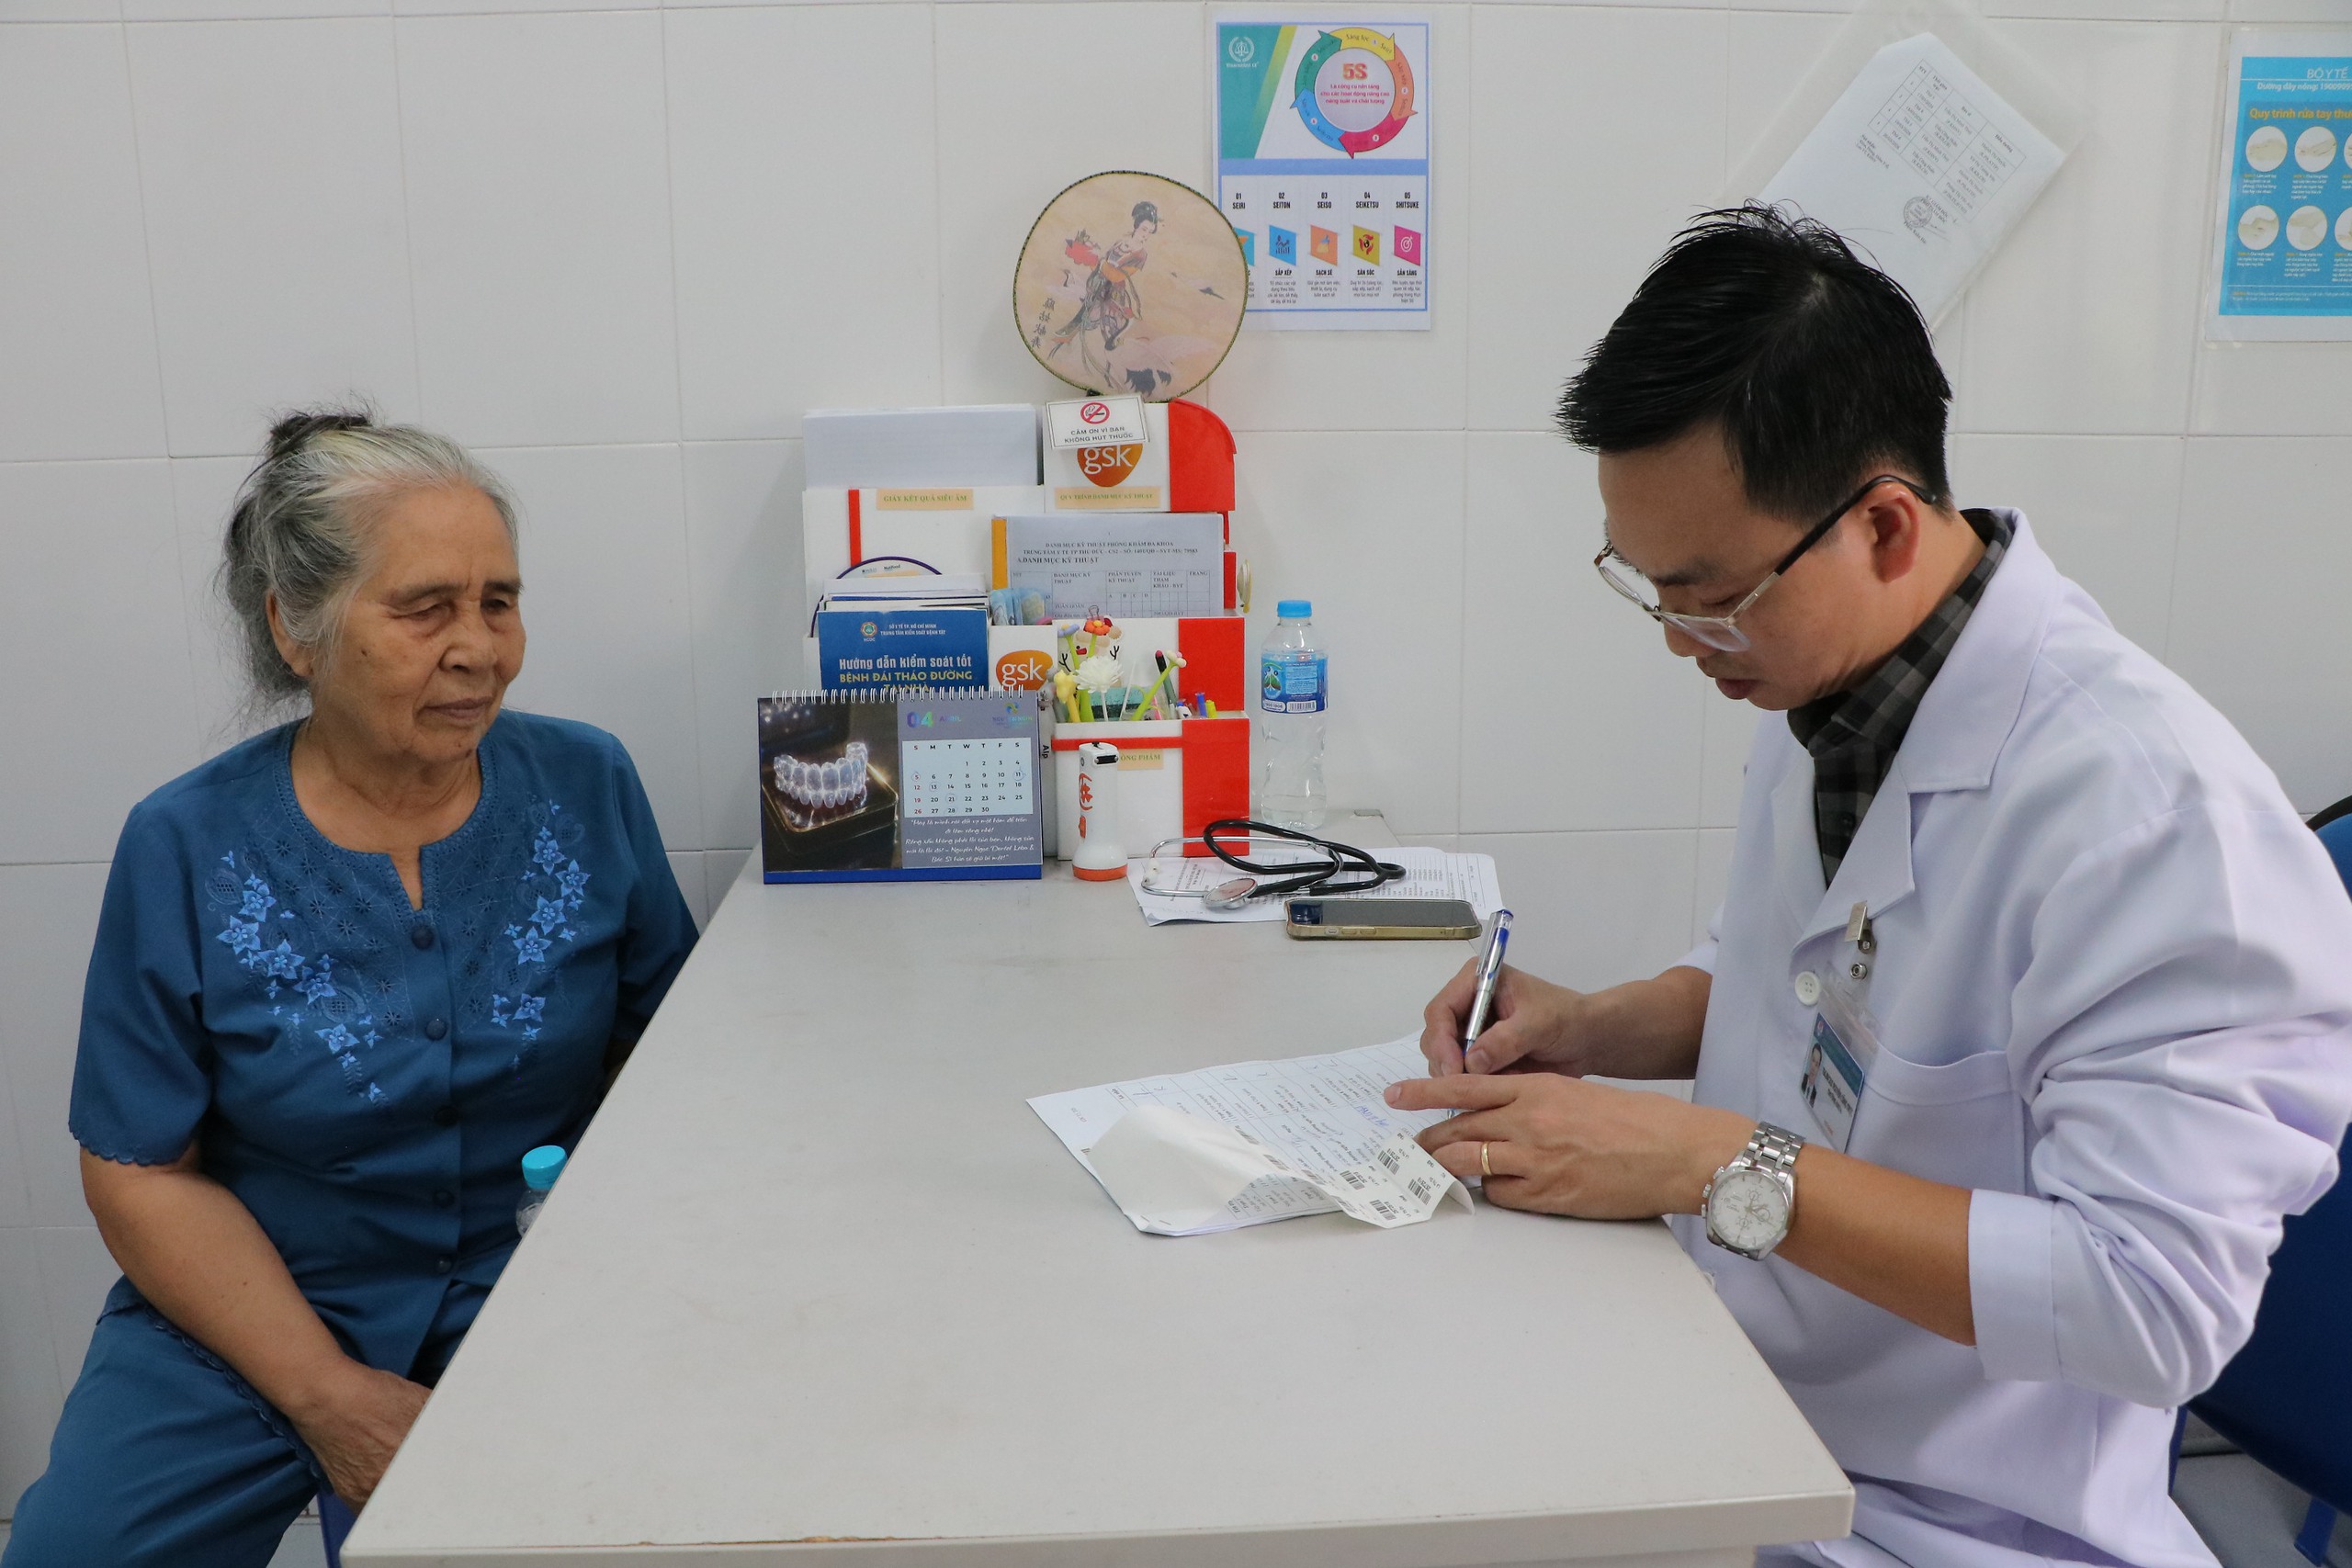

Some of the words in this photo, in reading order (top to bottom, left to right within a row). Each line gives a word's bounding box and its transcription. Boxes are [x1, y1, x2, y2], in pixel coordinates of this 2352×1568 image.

[1342, 62, 1368, 80] 5S
[2326, 68, 2333, 79] Y
[2335, 66, 2348, 79] TẾ
[2249, 108, 2269, 121] Quy
[2316, 110, 2332, 120] tay
[1084, 445, 1134, 475] gsk
[840, 658, 873, 671] Hướng
[876, 655, 896, 669] dẫn
[900, 654, 926, 668] kiểm
[930, 656, 953, 667] soát
[956, 654, 972, 667] tốt
[840, 671, 869, 683] BỆNH
[873, 671, 891, 682] ĐÁI
[895, 670, 927, 681] THÁO
[930, 670, 972, 681] ĐƯỜNG
[1001, 658, 1044, 687] gsk
[907, 711, 933, 728] 04
